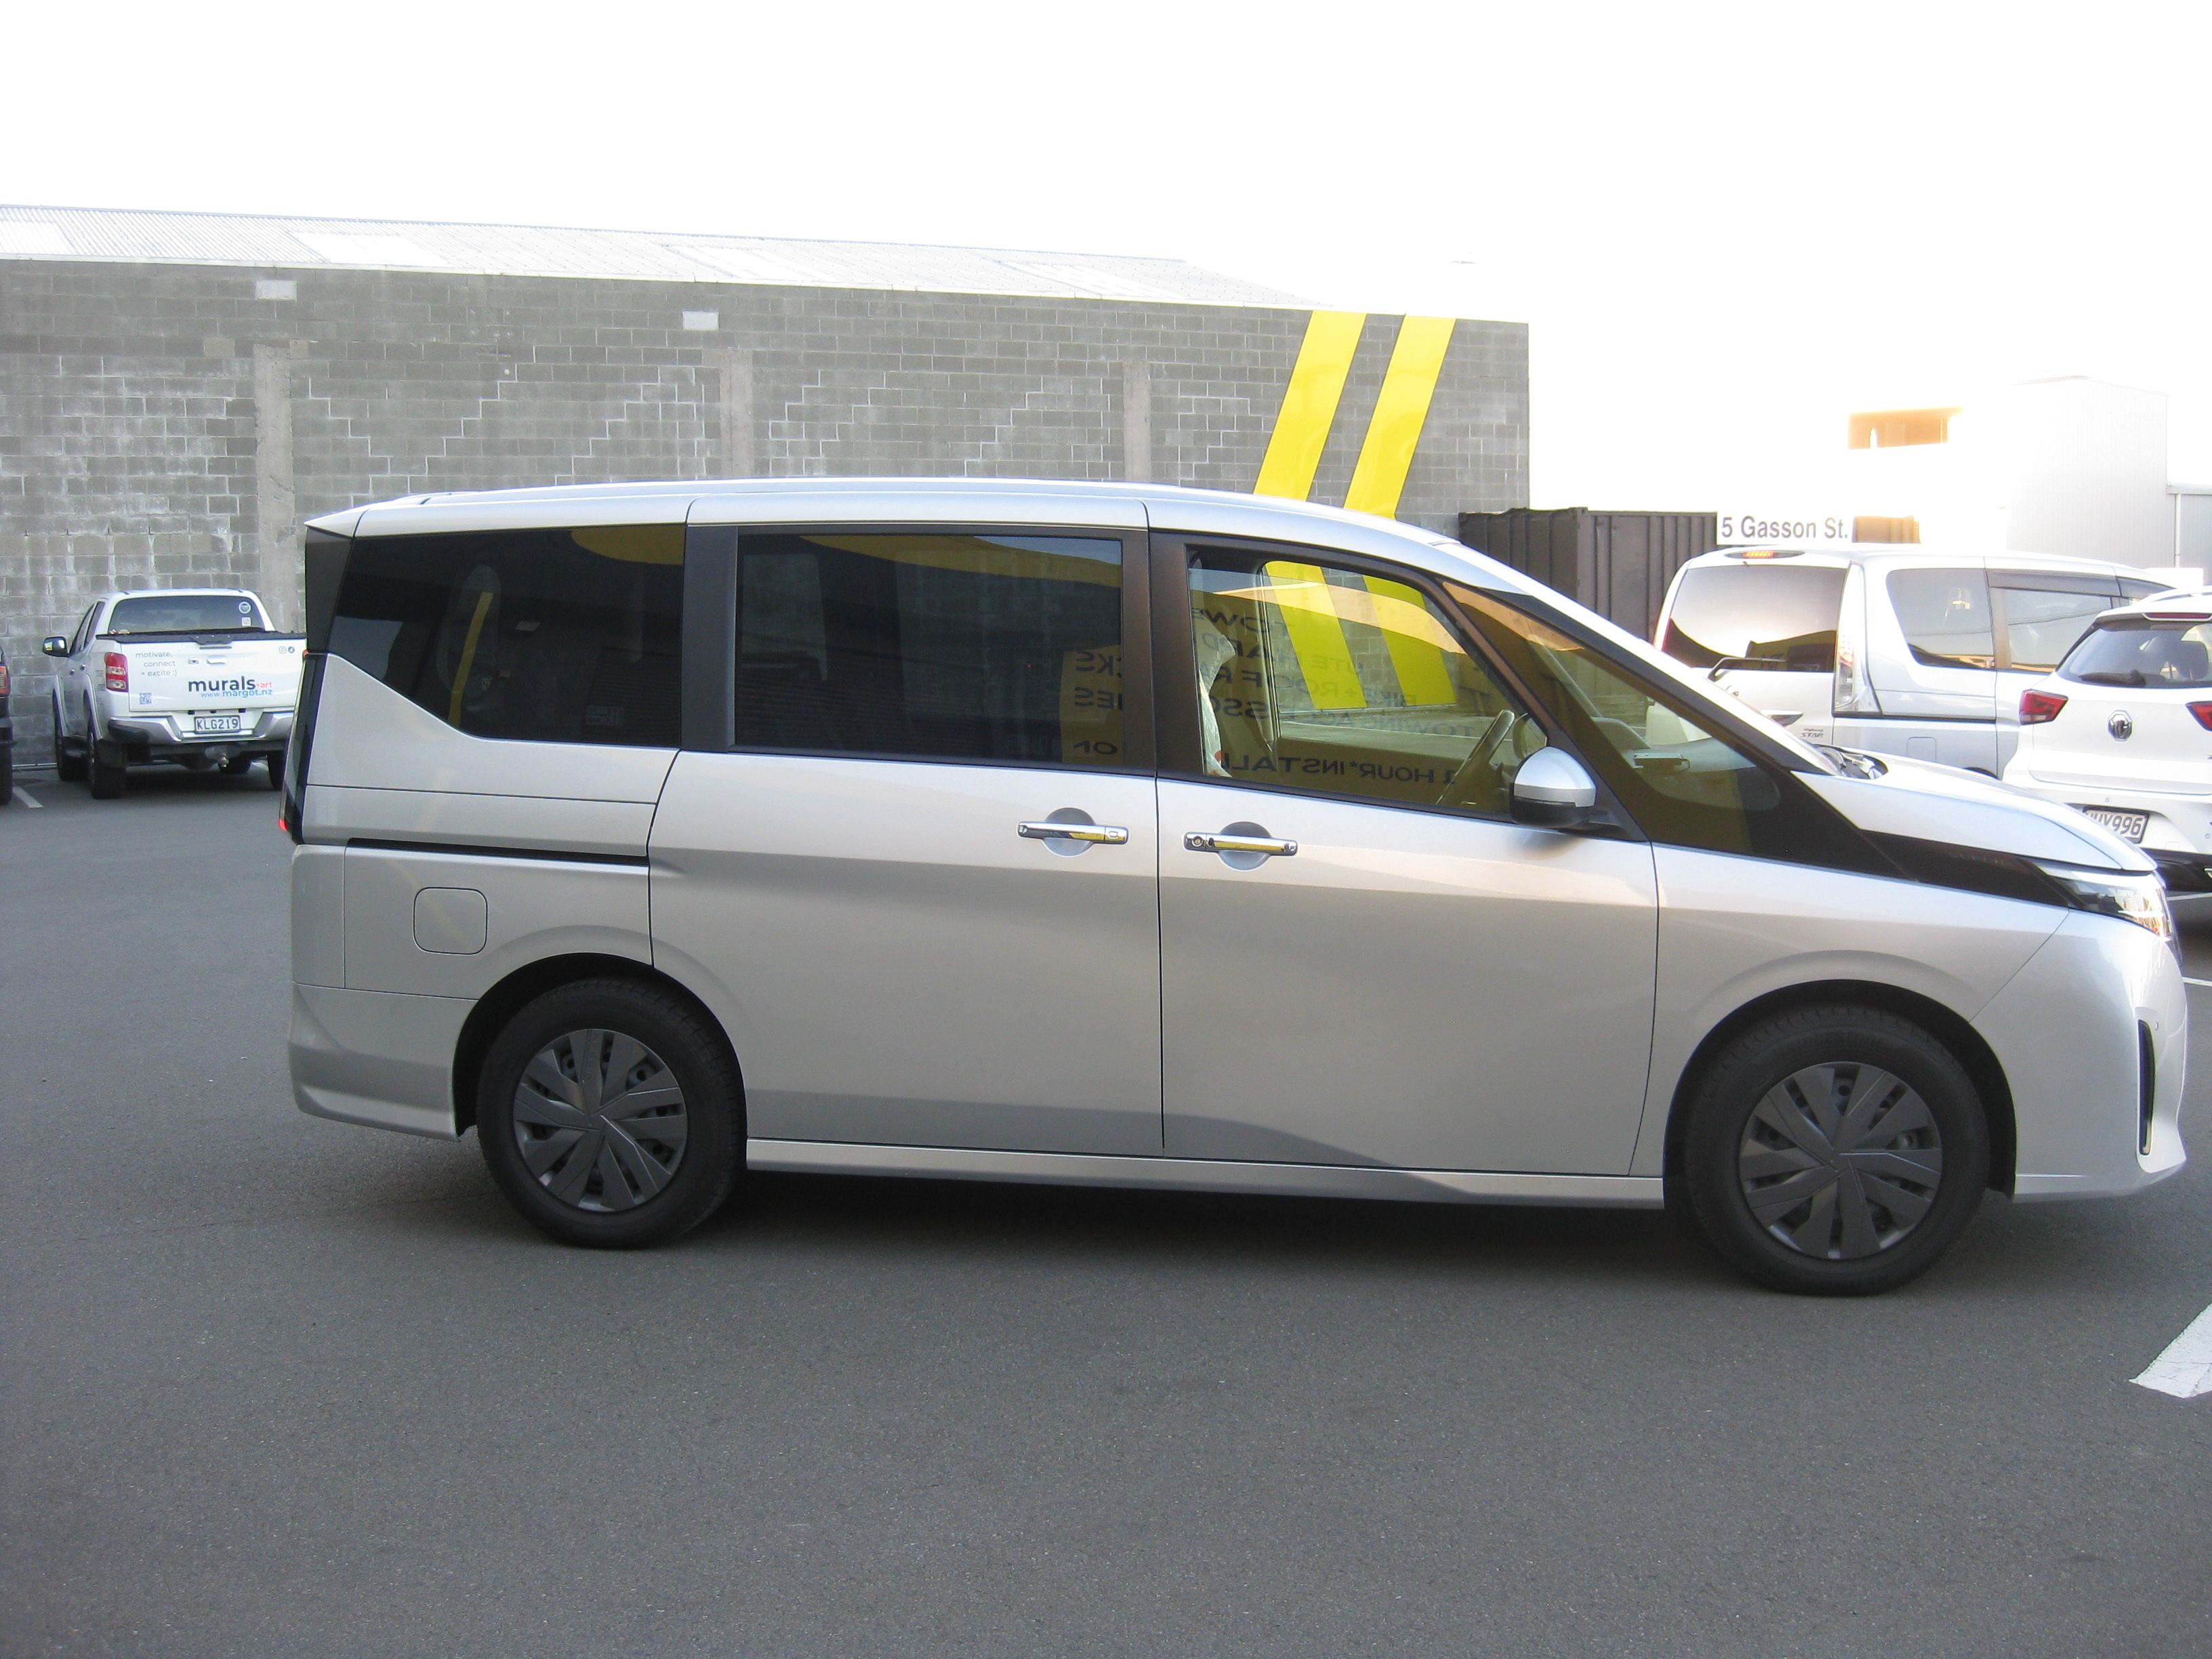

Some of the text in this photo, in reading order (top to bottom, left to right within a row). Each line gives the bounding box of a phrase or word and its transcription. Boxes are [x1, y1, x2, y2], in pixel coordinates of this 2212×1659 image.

[1721, 515, 1848, 539] 5 Gasson St.
[201, 689, 273, 699] www.margot.nz
[196, 718, 239, 731] KLG219
